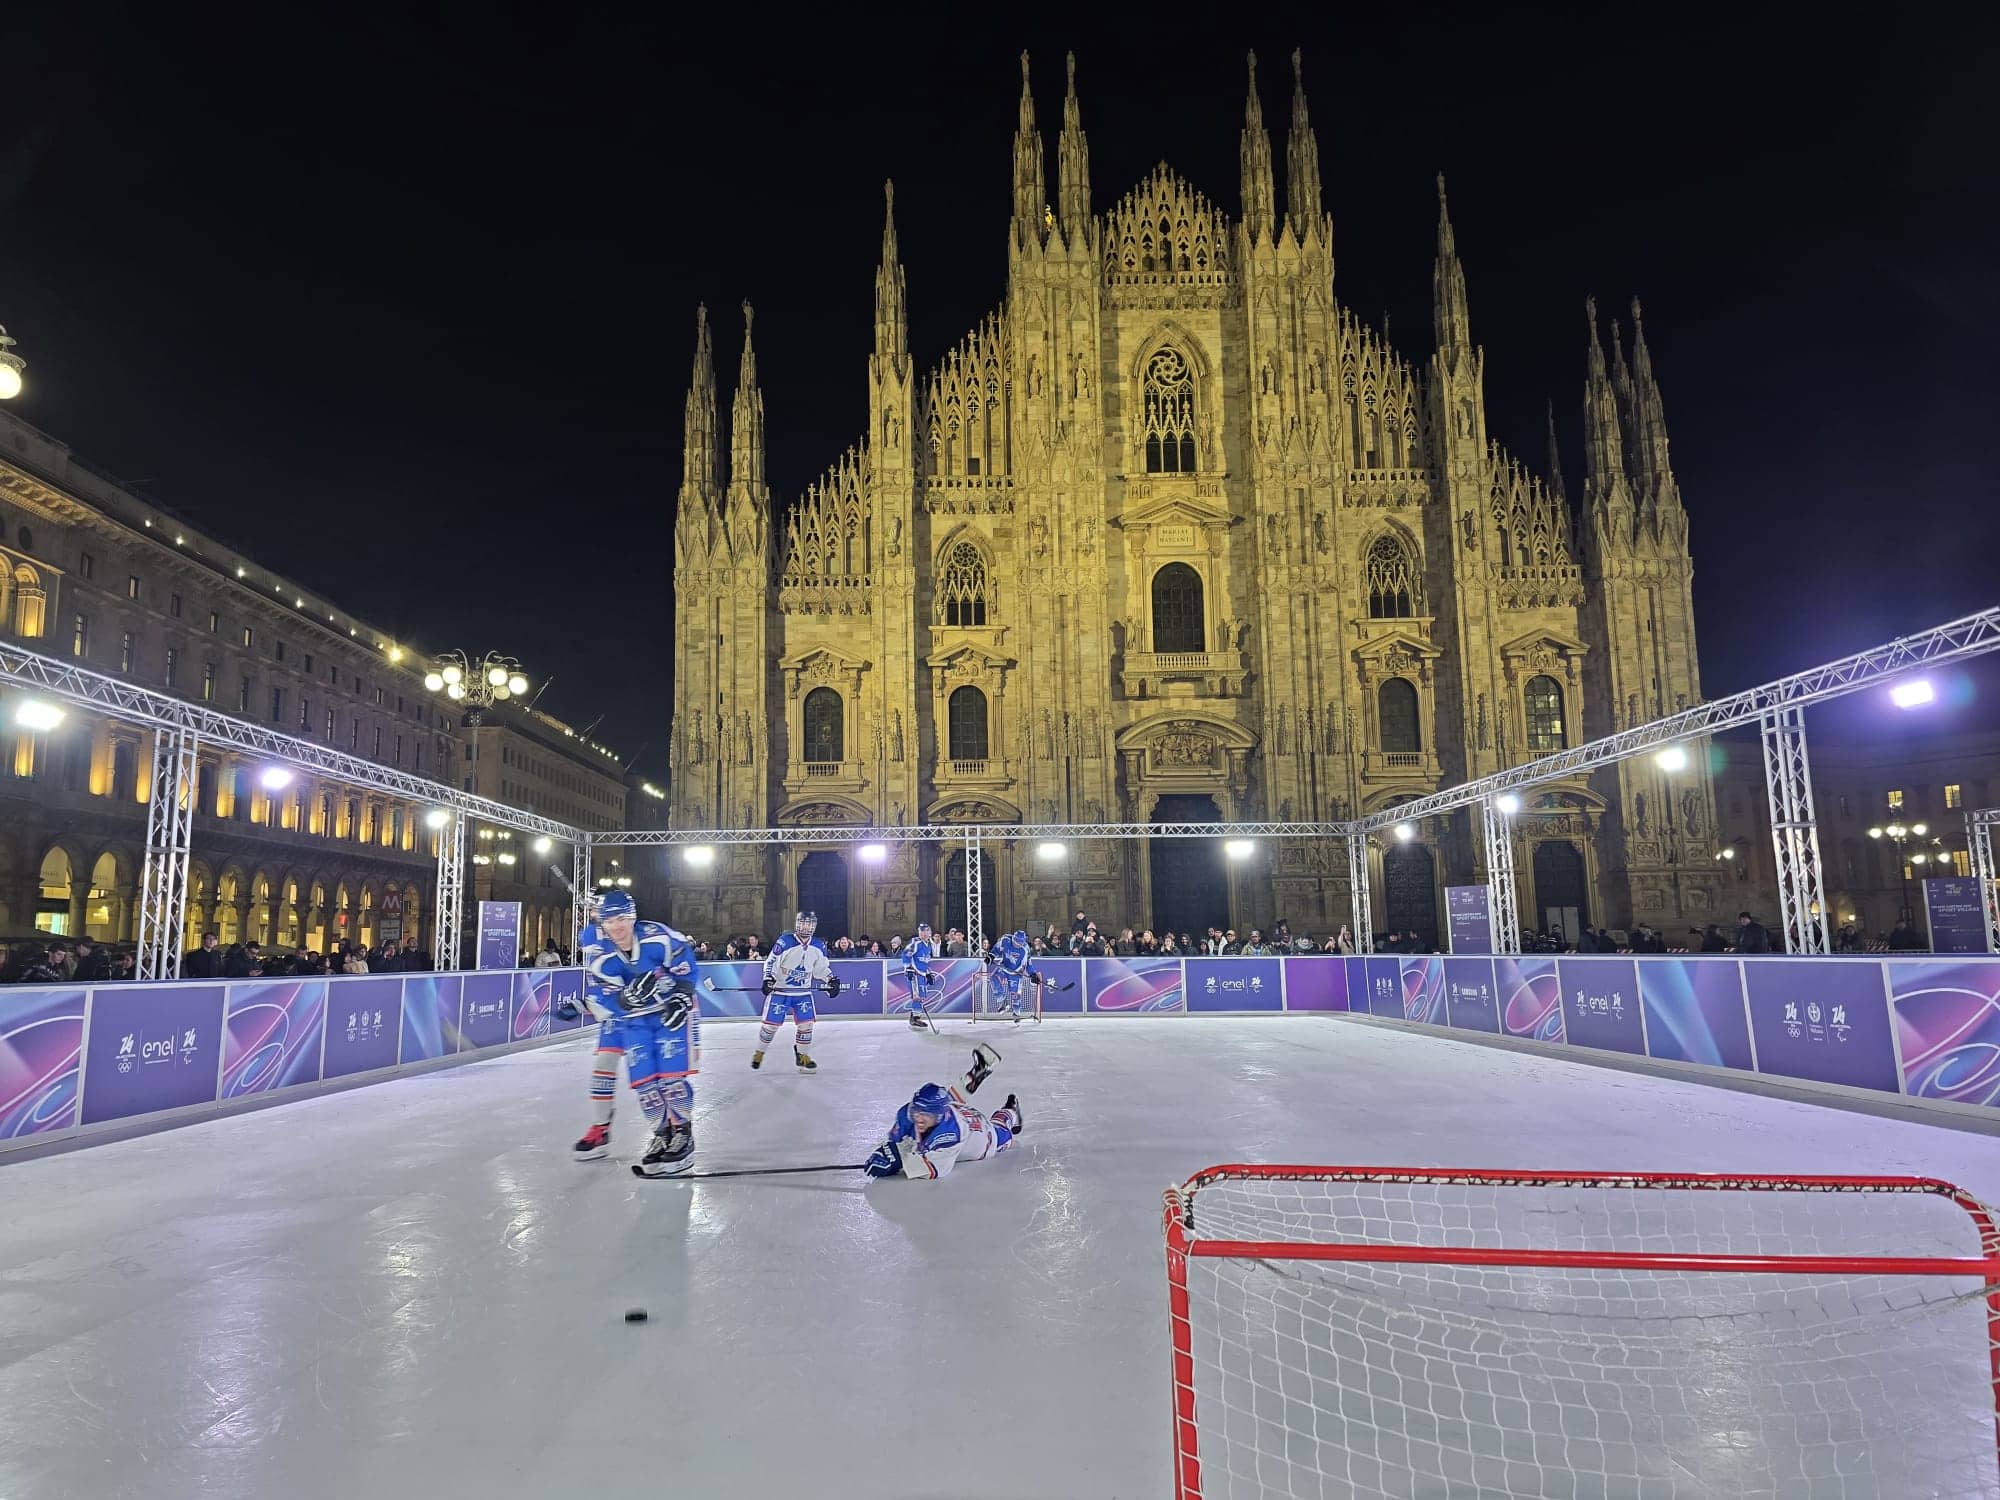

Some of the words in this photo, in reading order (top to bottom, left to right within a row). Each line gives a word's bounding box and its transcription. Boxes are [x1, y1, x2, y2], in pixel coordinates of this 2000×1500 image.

[382, 895, 400, 909] M
[1222, 978, 1245, 989] enel
[1589, 994, 1609, 1010] enel
[142, 1034, 175, 1059] enel
